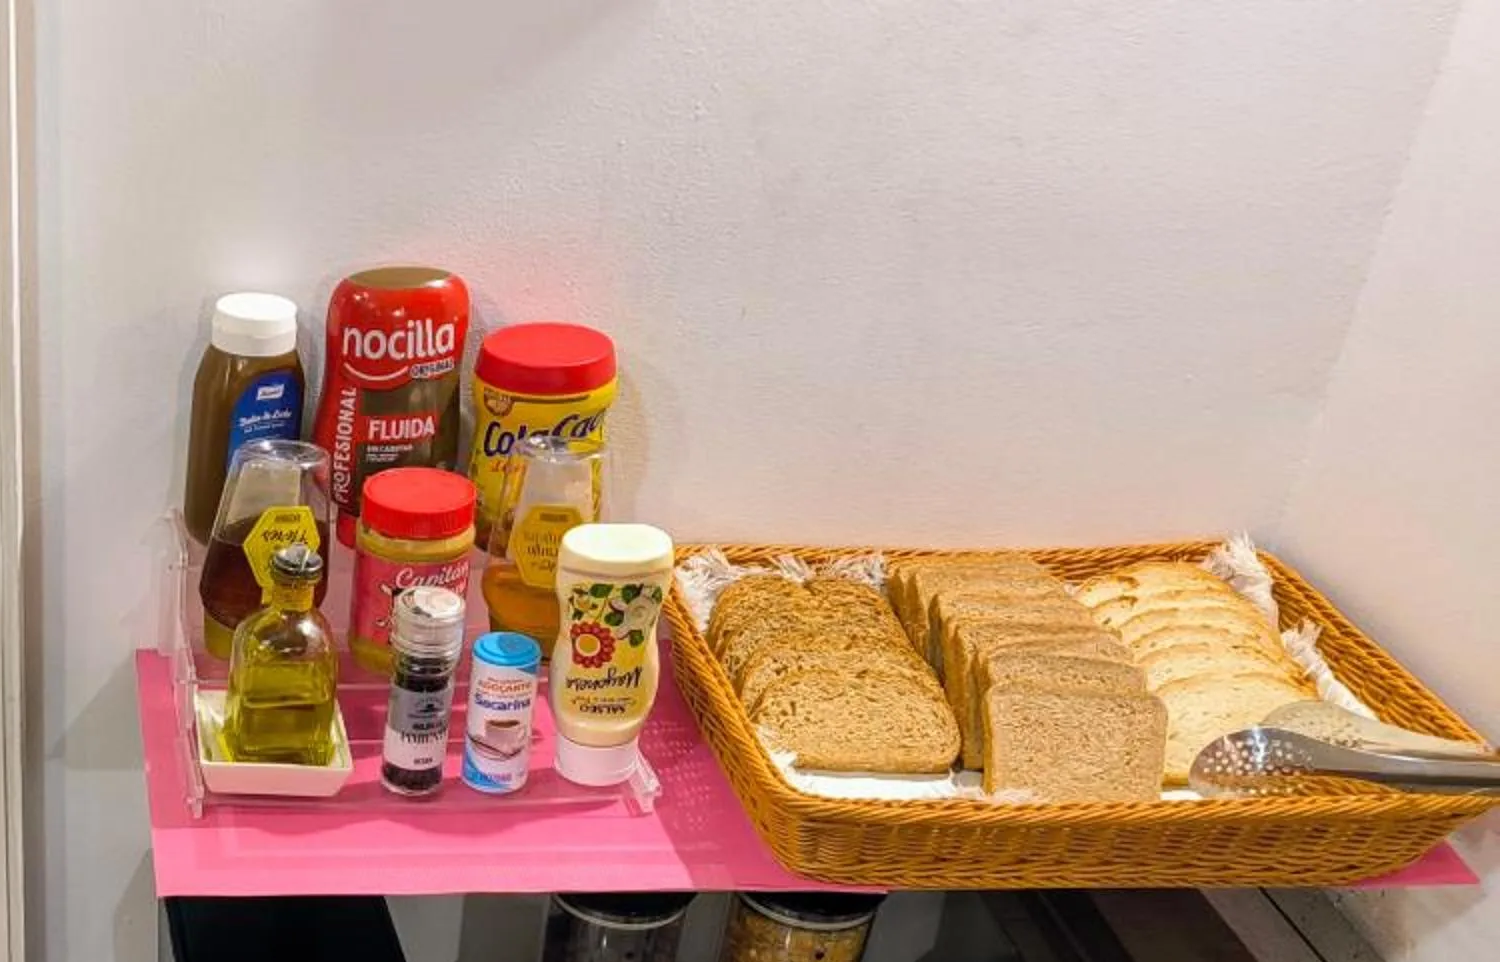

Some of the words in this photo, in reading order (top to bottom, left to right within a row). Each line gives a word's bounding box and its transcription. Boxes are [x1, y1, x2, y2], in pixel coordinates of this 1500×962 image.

[342, 318, 455, 360] nocilla
[333, 387, 357, 504] PROFESIONAL
[368, 416, 436, 440] FLUIDA
